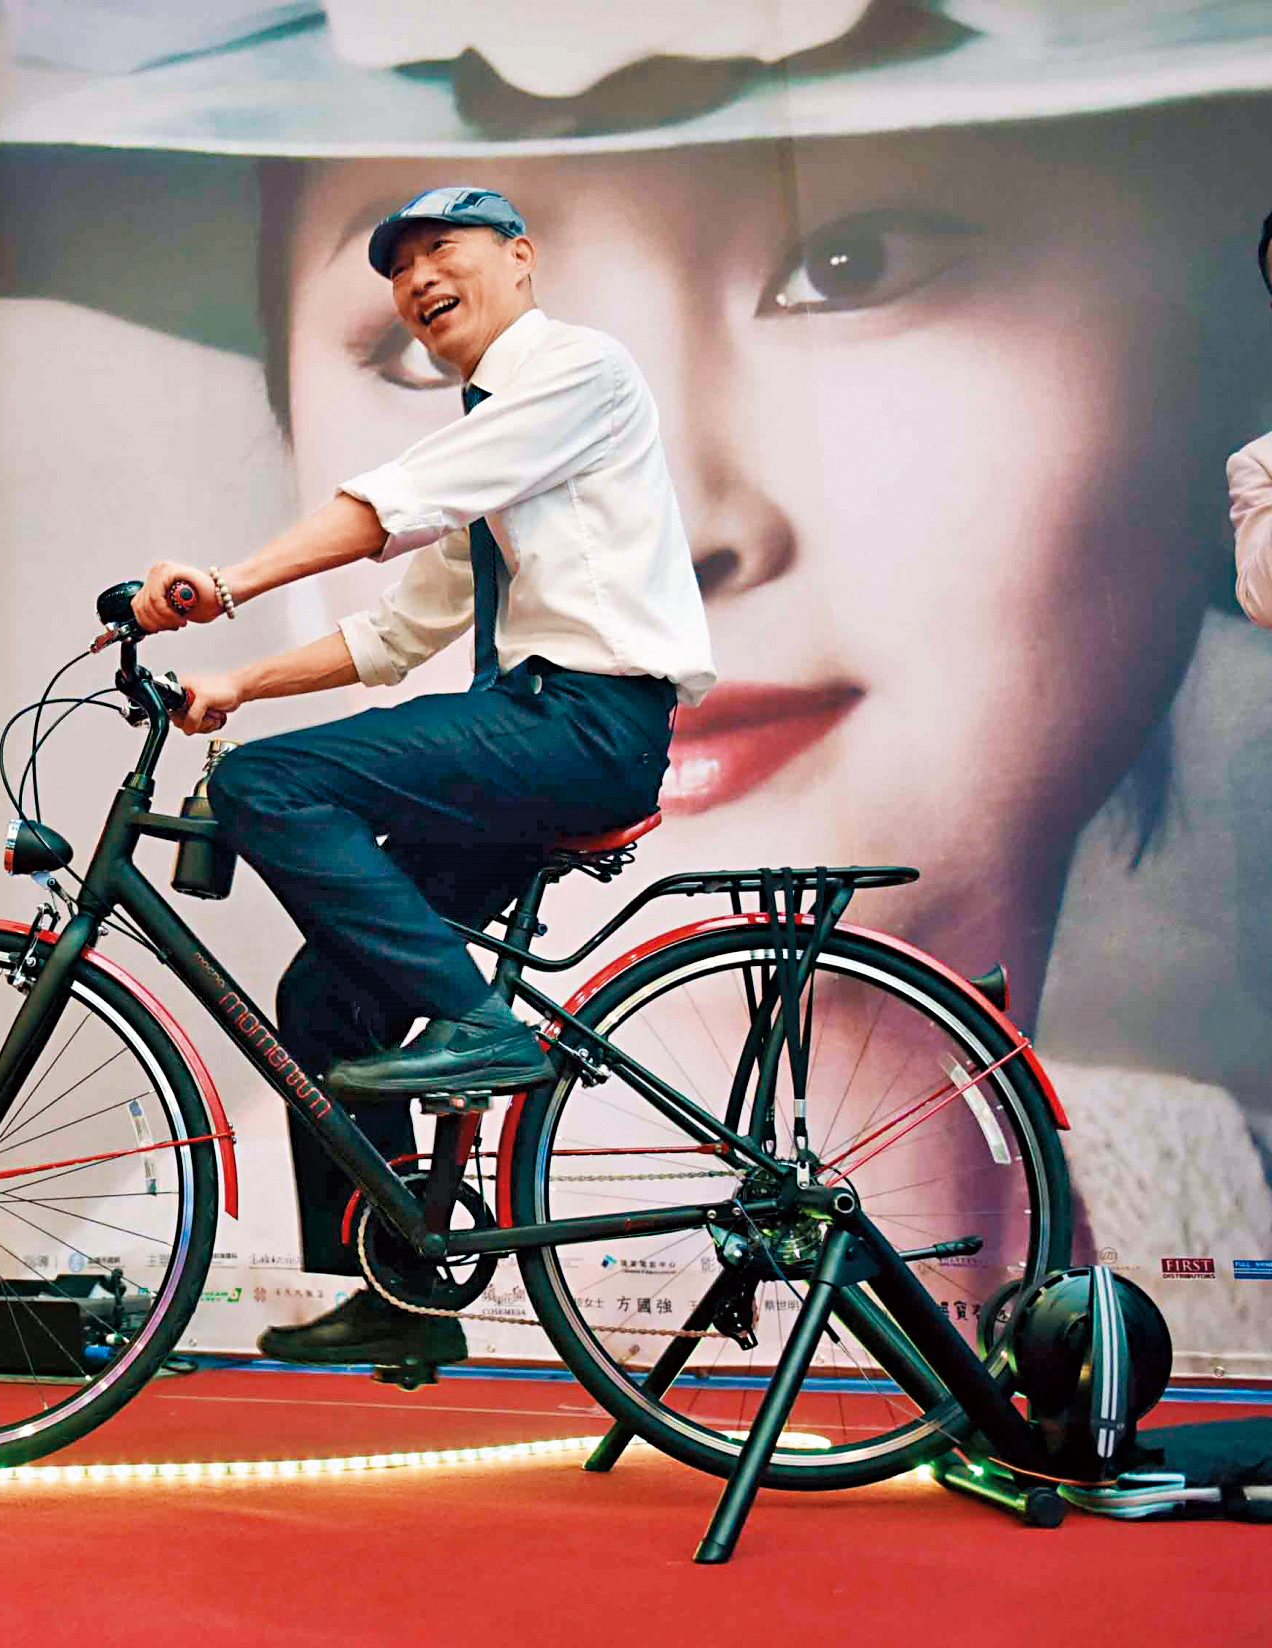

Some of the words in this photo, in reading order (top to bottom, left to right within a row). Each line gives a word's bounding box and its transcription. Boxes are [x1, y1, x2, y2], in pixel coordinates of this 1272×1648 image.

[218, 991, 332, 1120] momentum
[1165, 1259, 1212, 1272] FIRST
[617, 1295, 674, 1315] 方國強
